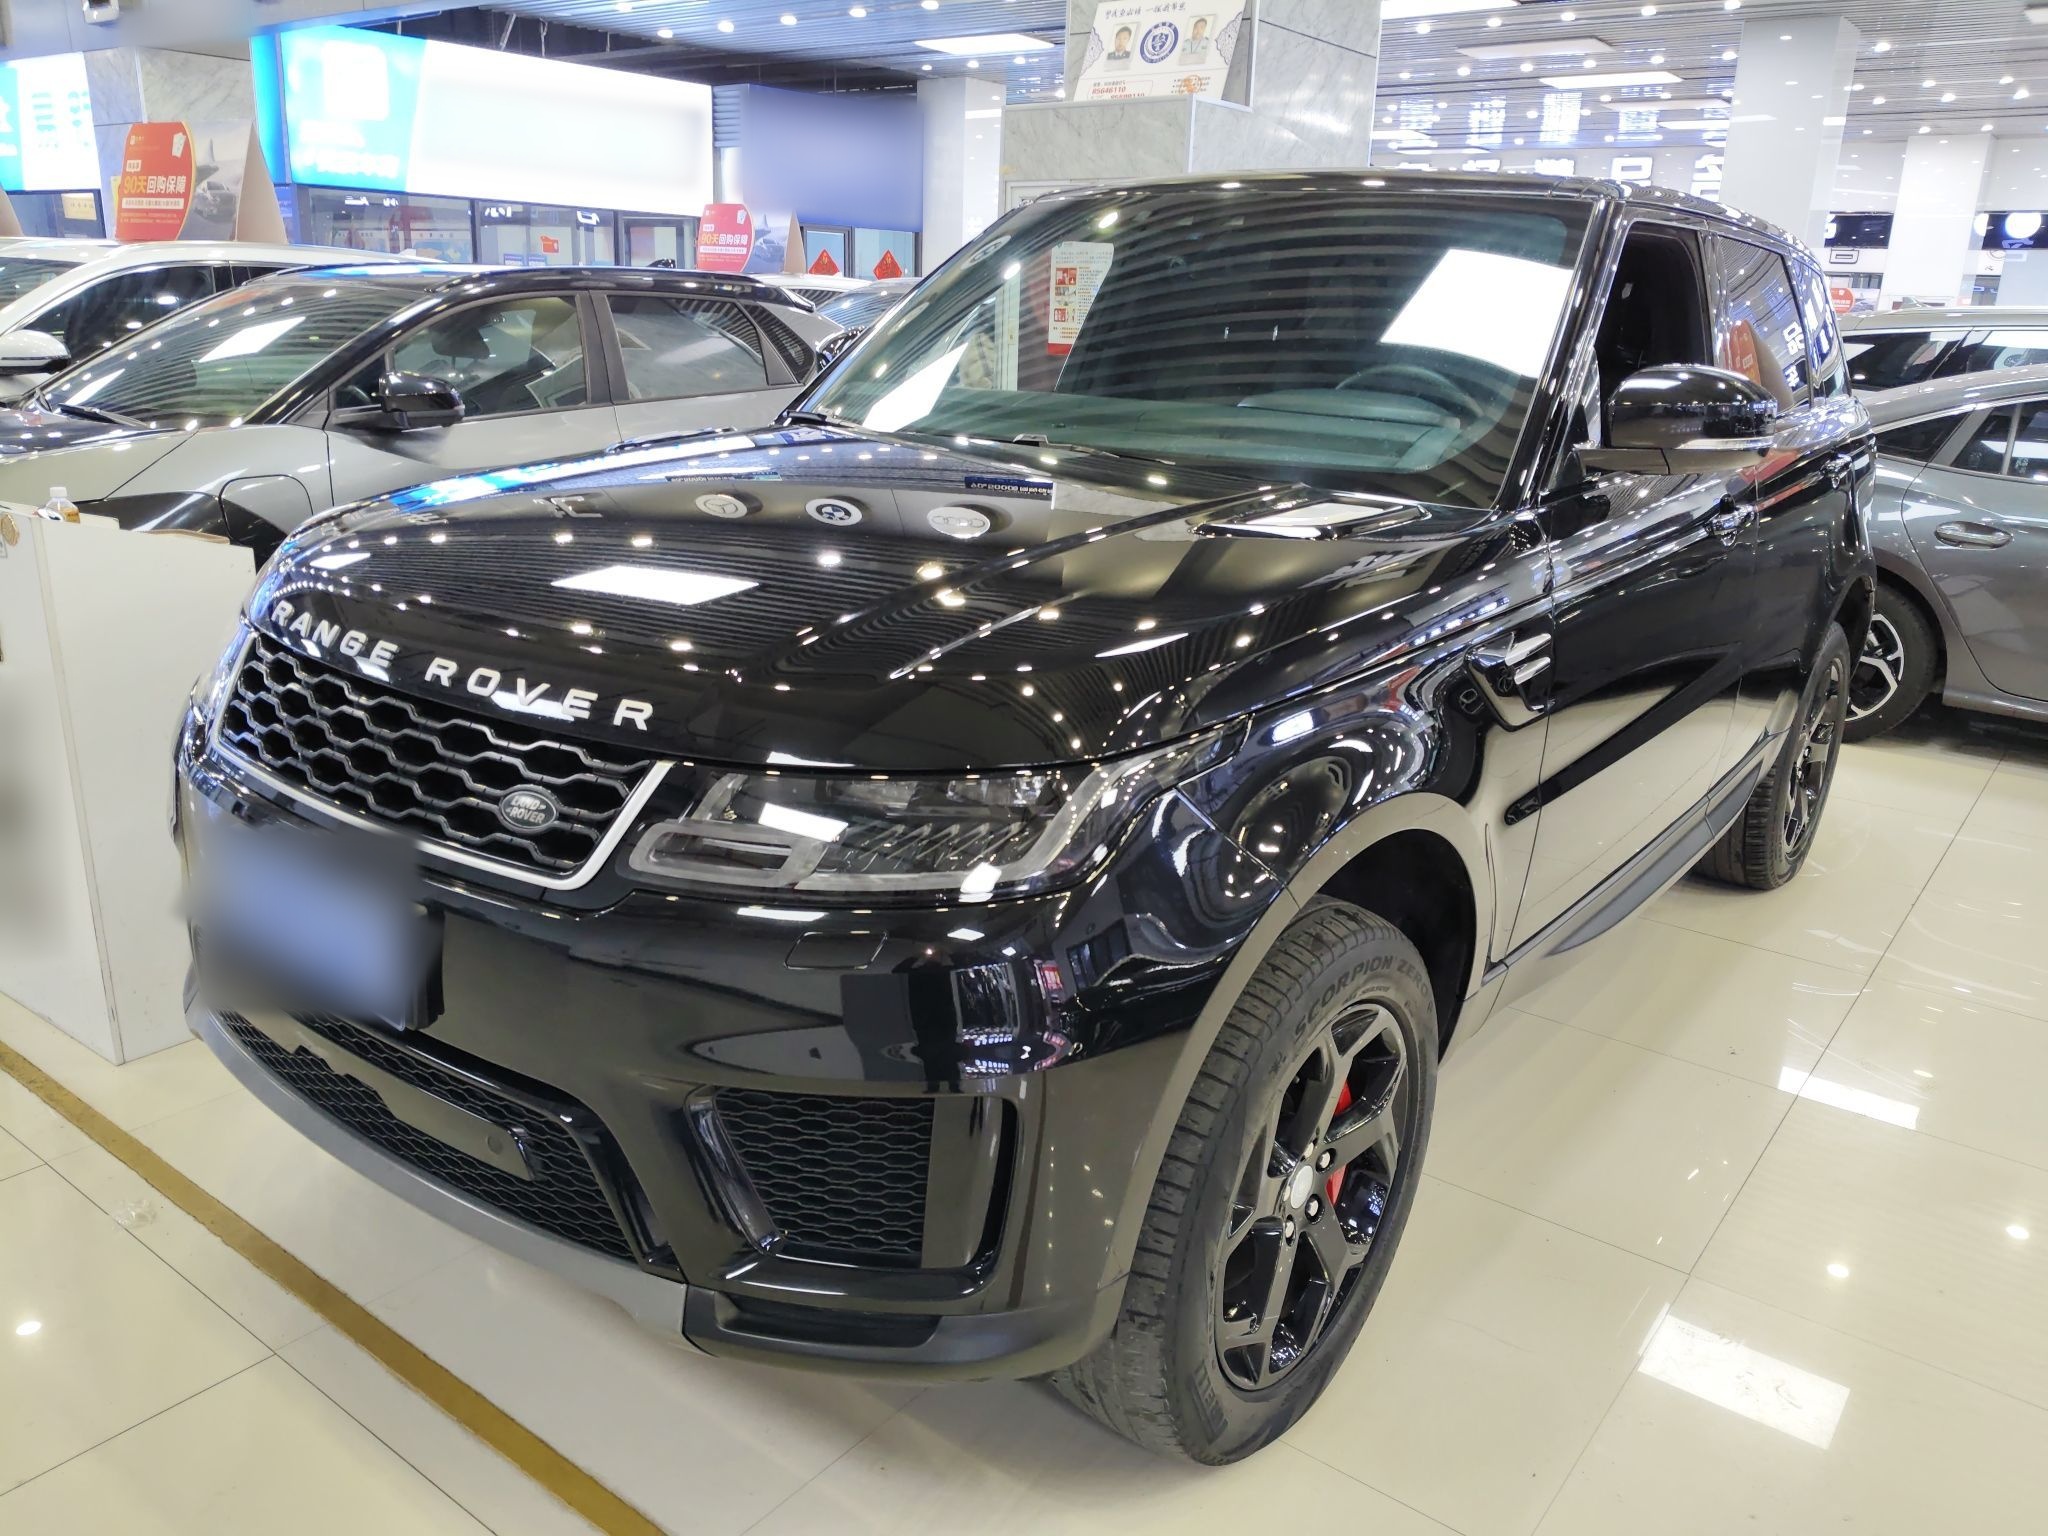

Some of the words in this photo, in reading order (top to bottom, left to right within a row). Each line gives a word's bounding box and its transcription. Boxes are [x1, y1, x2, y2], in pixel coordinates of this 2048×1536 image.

[124, 175, 187, 194] 90天回购保障
[271, 600, 399, 668] RANGE
[425, 656, 654, 731] ROVER
[511, 795, 541, 811] LAND
[510, 806, 546, 824] ROVER
[1295, 955, 1393, 1038] SCORPION
[1396, 958, 1429, 998] ZERO
